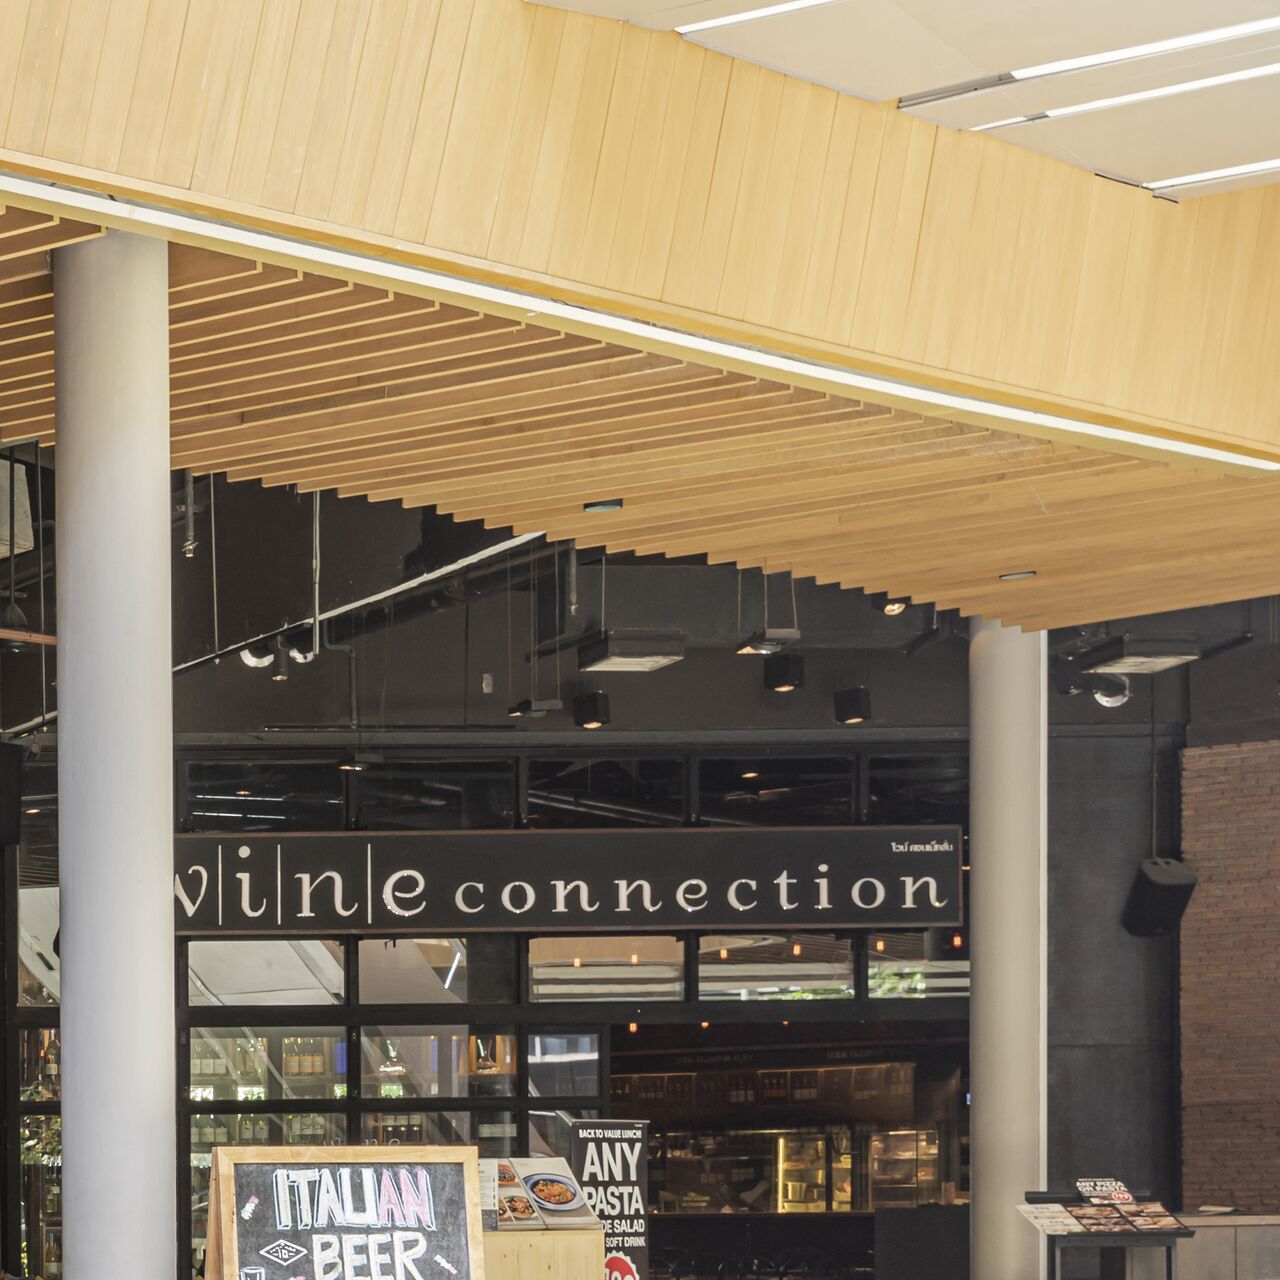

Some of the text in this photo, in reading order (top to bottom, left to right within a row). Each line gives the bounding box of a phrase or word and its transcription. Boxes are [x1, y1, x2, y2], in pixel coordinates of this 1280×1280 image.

[454, 863, 948, 915] connection
[579, 1129, 595, 1138] BACK
[595, 1129, 603, 1138] TO
[604, 1129, 621, 1139] VALUE
[582, 1142, 642, 1181] ANY
[272, 1168, 437, 1231] ITALIAN
[582, 1186, 645, 1215] PASTA
[613, 1218, 645, 1233] SALAD
[605, 1236, 645, 1248] SOFT DRINK
